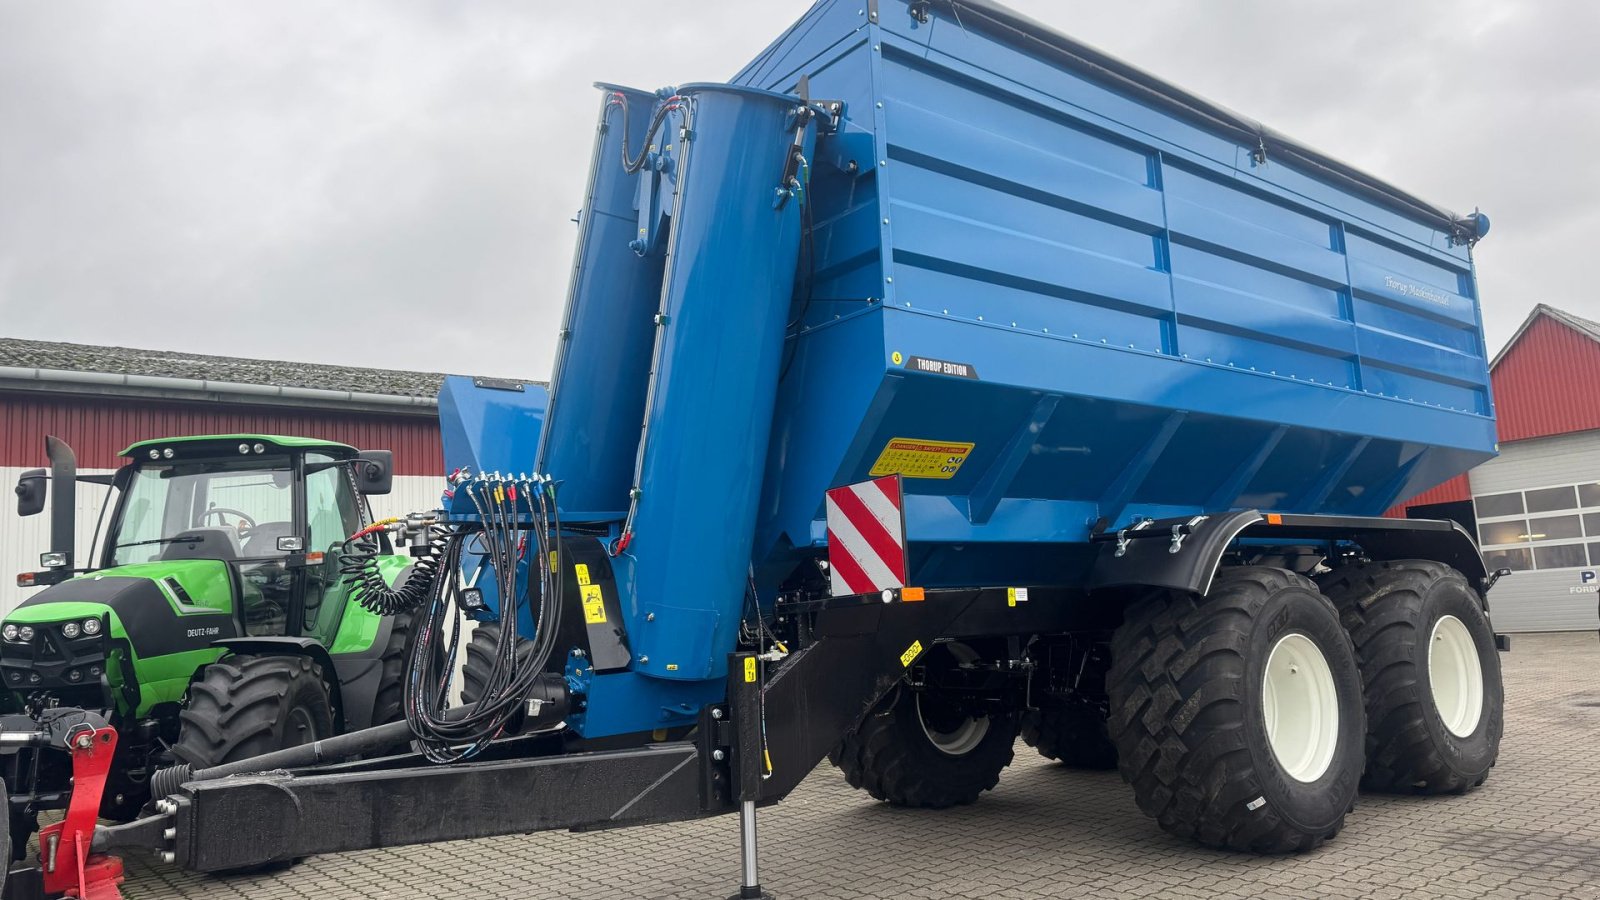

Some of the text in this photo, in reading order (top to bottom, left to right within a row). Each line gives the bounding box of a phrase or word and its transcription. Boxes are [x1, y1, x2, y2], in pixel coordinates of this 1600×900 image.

[1384, 276, 1408, 296] Thorup
[917, 358, 967, 377] THORUP EDITION
[894, 443, 916, 451] DANGER
[1580, 571, 1596, 584] P
[187, 626, 220, 638] DEUTZ-FAHR
